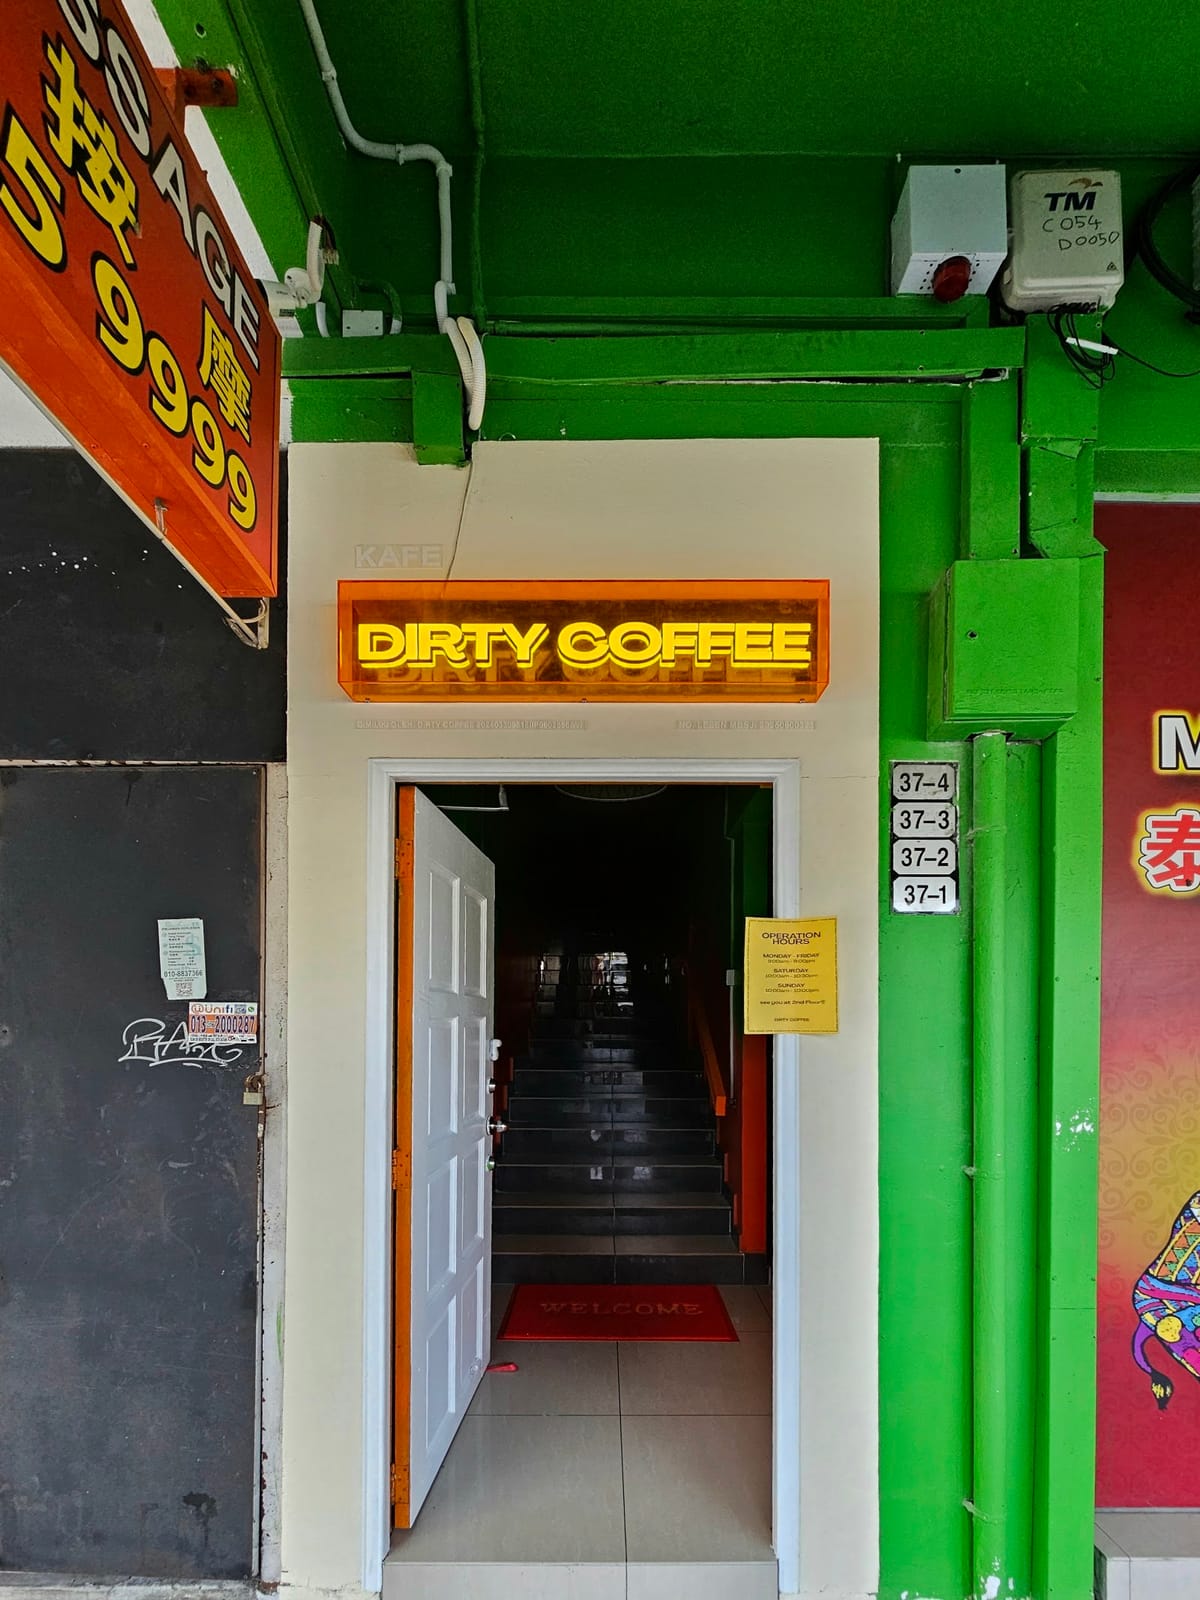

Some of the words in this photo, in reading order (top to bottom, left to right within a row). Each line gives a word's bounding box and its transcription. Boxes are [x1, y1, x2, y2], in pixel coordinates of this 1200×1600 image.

[1043, 191, 1096, 211] TM
[355, 545, 441, 568] KAFE
[357, 622, 550, 669] DIRTY
[557, 621, 812, 669] COFFEE
[899, 772, 950, 792] 37-4
[899, 810, 950, 830] 37-3
[900, 847, 949, 867] 37-2
[903, 884, 948, 905] 37-1
[761, 931, 822, 939] OPERATION
[540, 1303, 704, 1315] WELCOME
